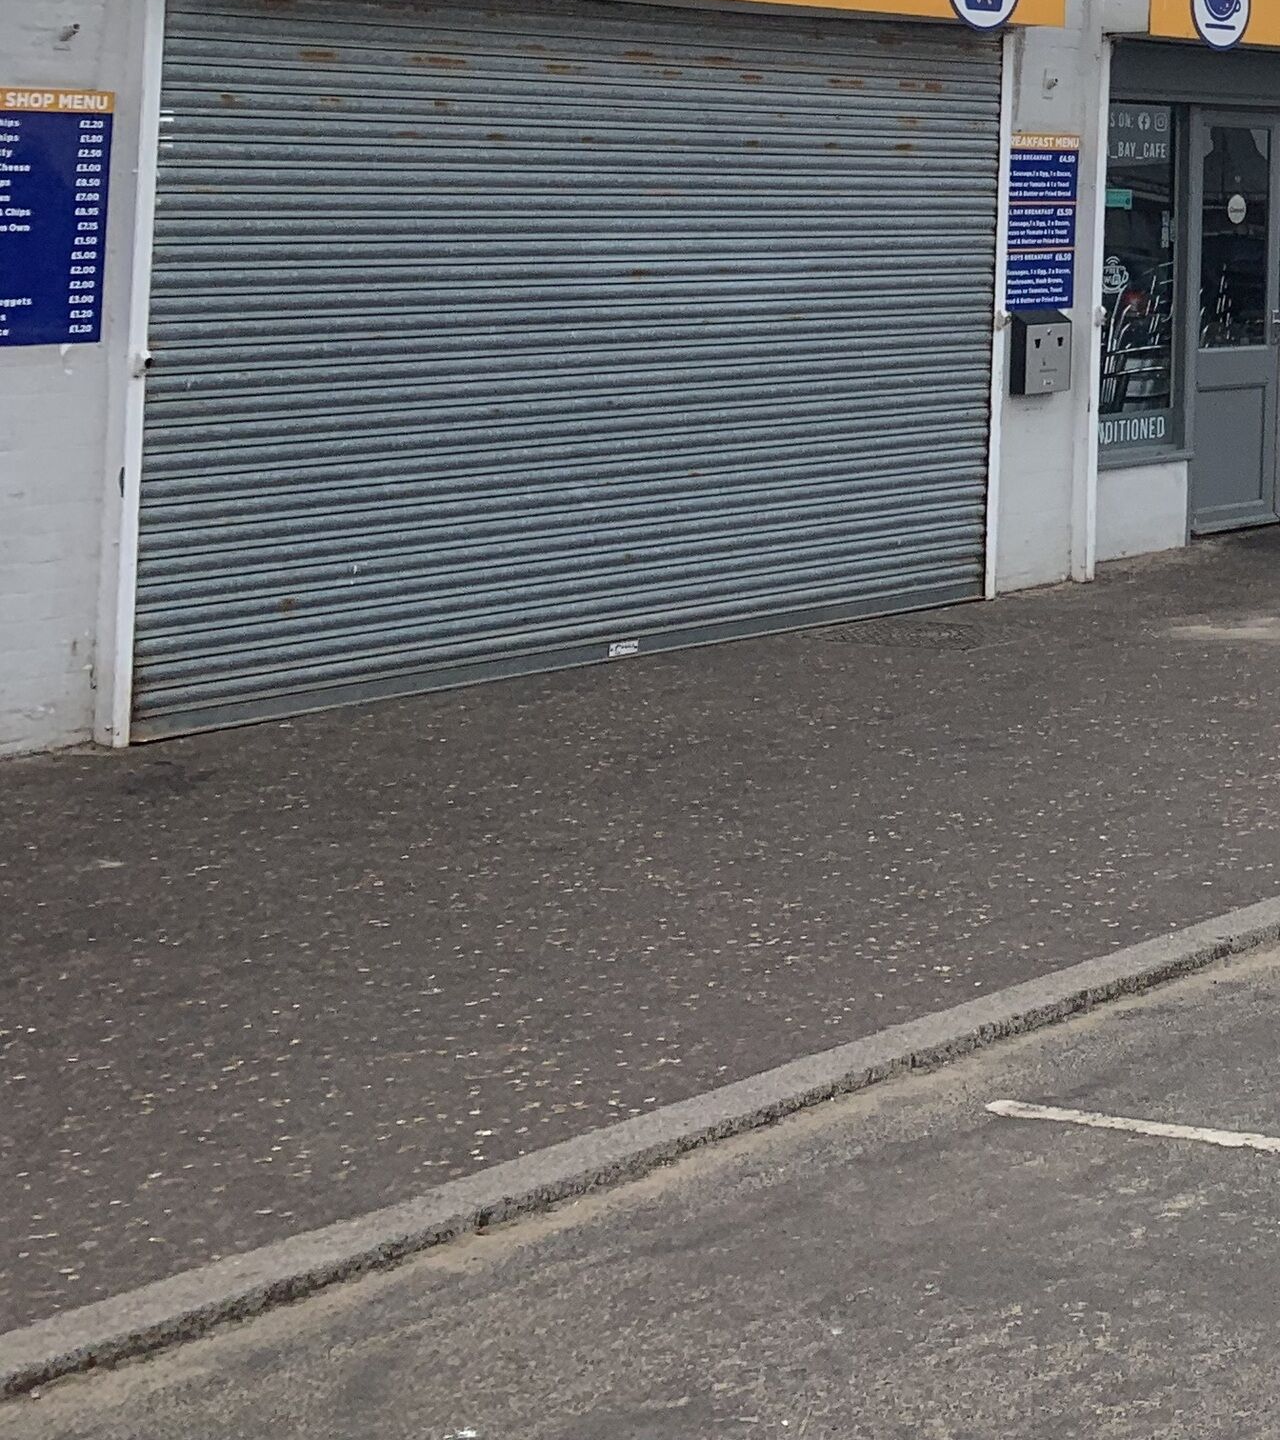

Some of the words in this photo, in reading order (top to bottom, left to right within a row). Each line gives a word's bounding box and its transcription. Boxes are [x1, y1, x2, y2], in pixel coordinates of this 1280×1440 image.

[5, 92, 54, 107] SHOP
[59, 94, 108, 109] MENU
[1110, 112, 1115, 127] S
[1010, 135, 1054, 147] REAKFAST
[1056, 137, 1079, 148] MENU
[1106, 142, 1166, 159] A_BAY_CAFE
[1098, 416, 1165, 444] NDITIONED
